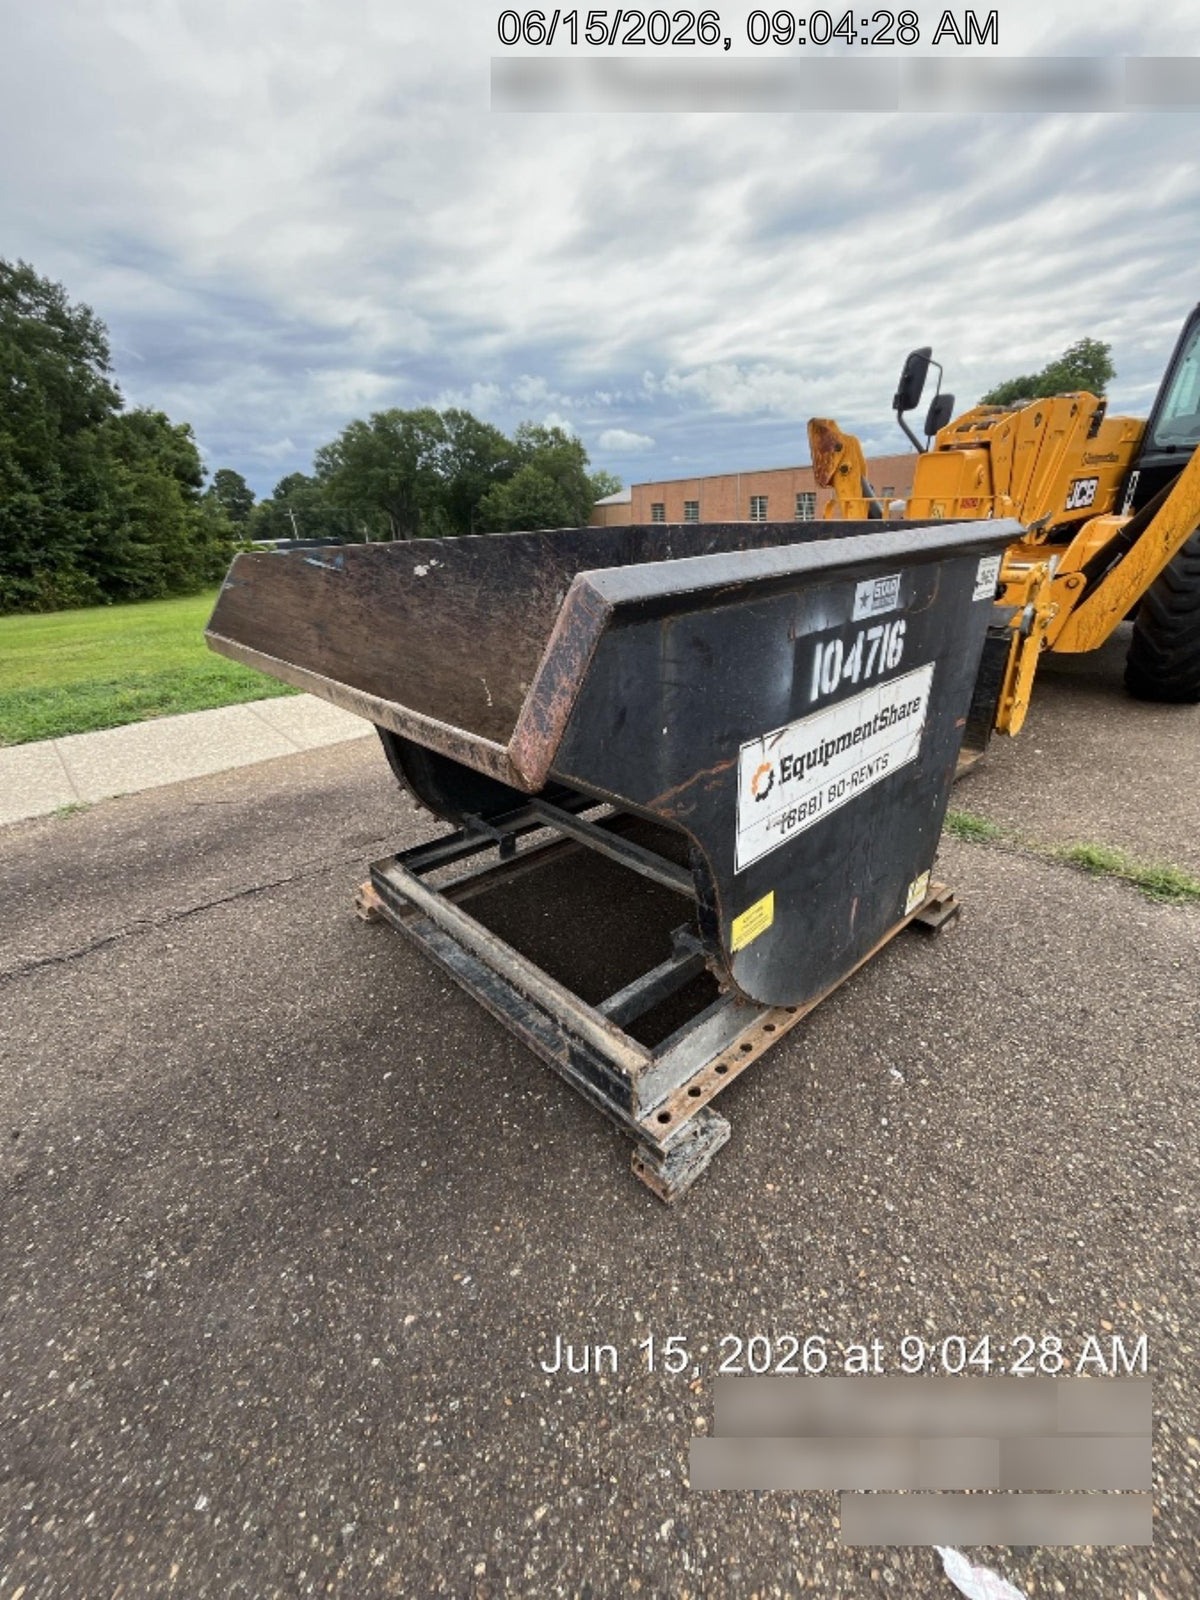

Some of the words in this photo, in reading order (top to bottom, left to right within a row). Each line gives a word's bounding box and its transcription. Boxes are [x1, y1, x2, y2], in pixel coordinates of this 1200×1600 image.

[1066, 479, 1099, 509] JCB
[809, 619, 907, 703] 104716
[780, 696, 922, 786] EquipmentShare
